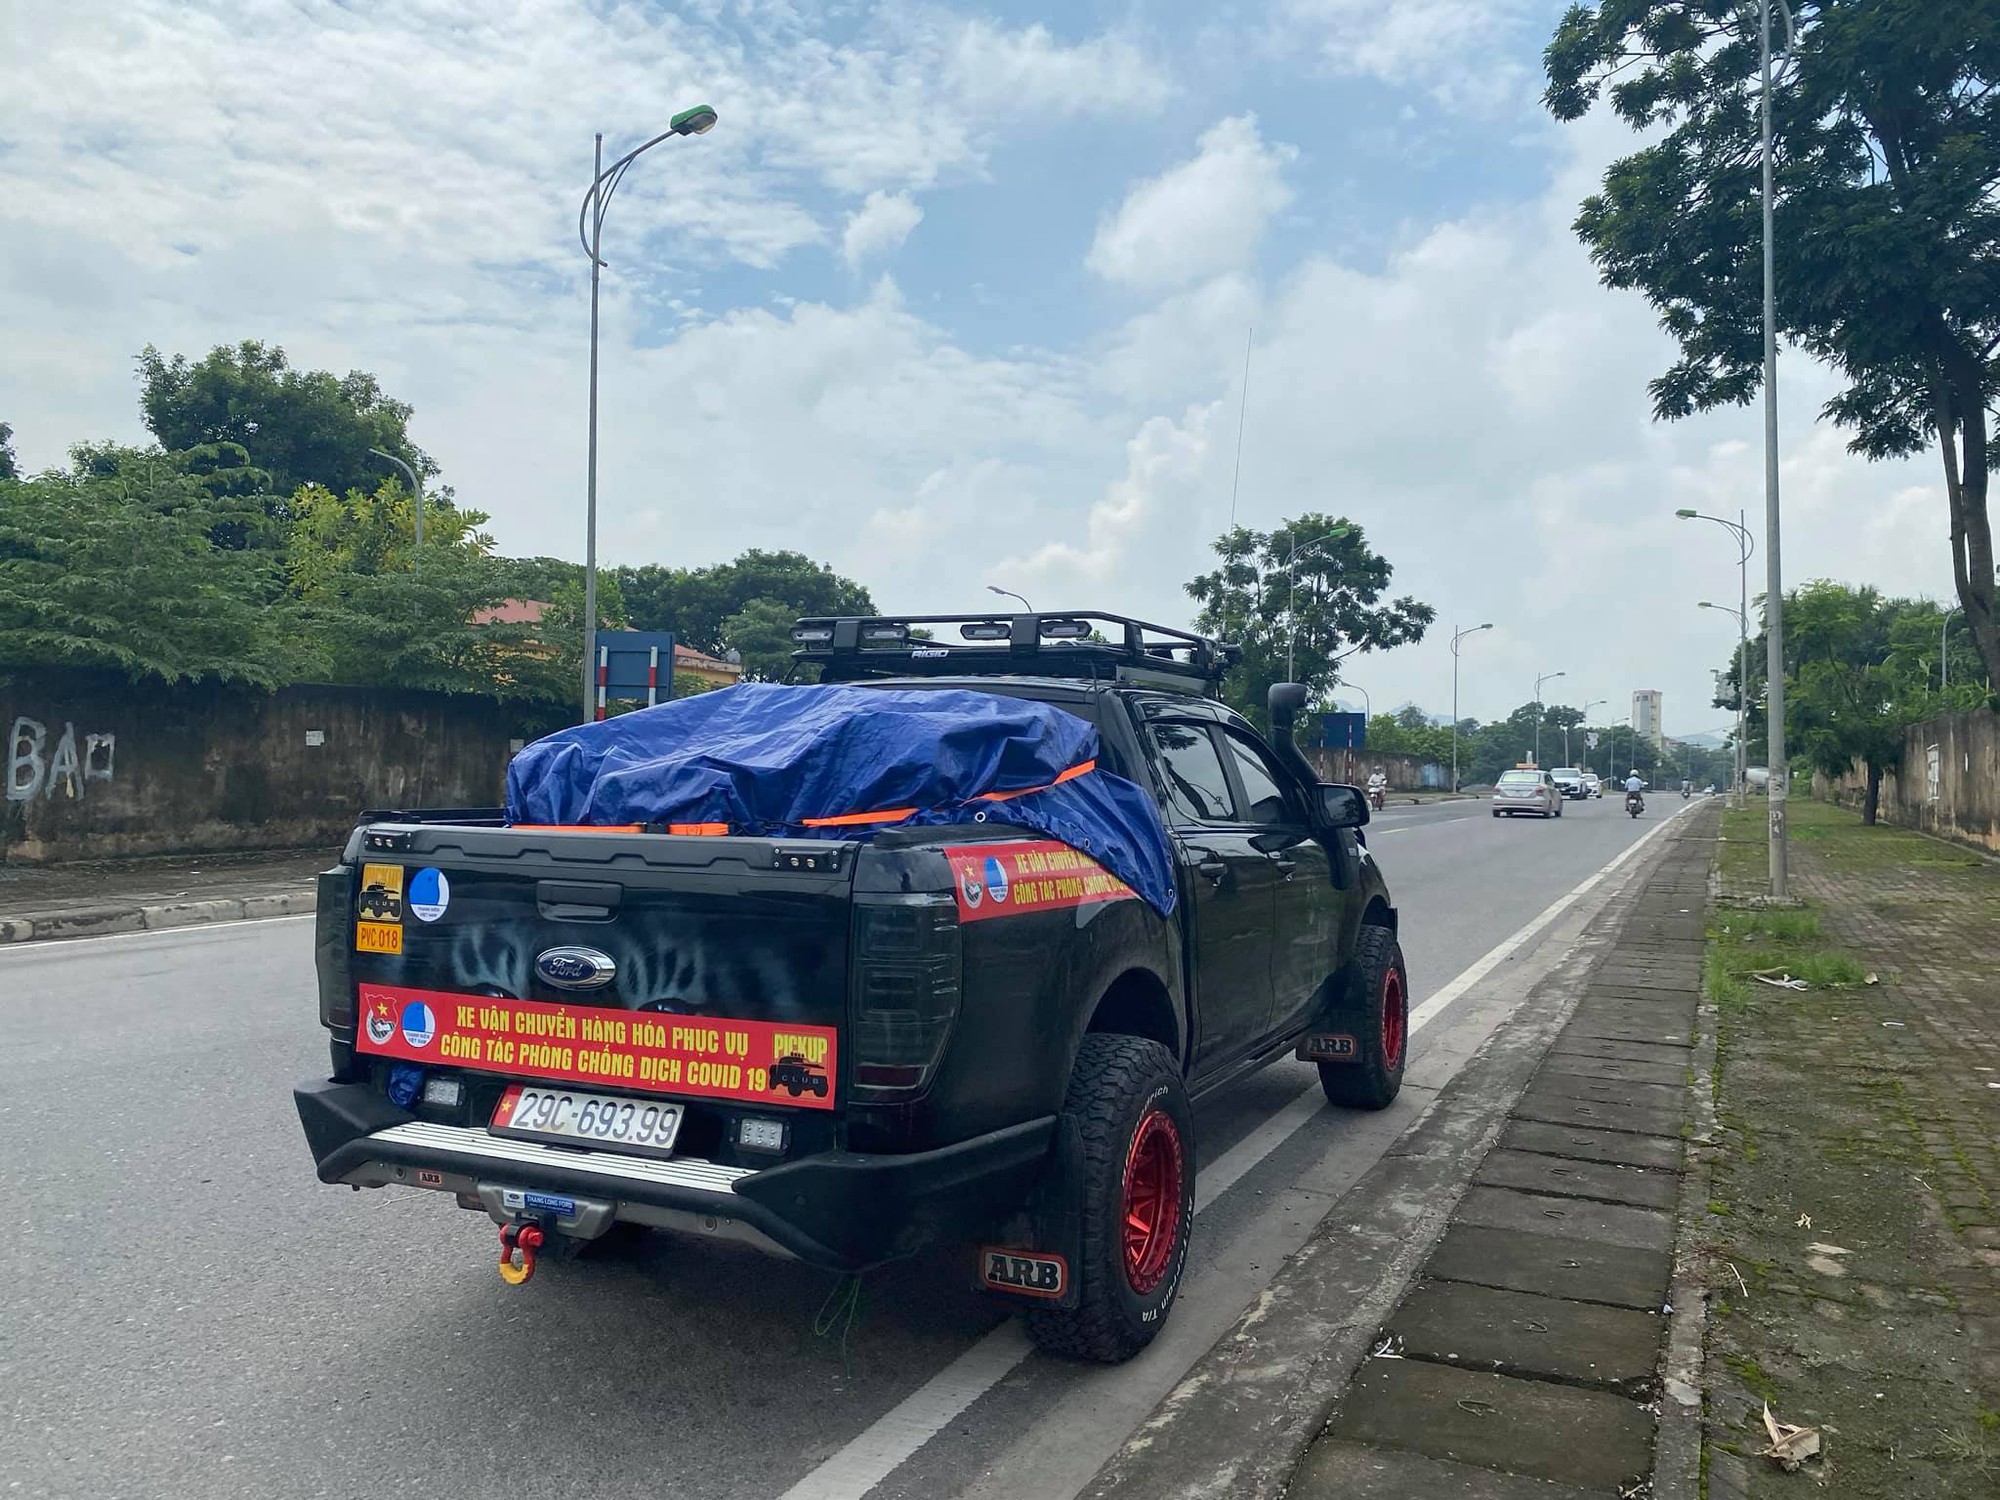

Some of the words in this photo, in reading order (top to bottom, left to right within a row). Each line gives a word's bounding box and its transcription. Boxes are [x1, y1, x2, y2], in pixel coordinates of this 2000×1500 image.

[361, 927, 376, 947] PVC
[378, 929, 398, 949] 018
[548, 956, 583, 979] Ford
[457, 1005, 475, 1028] XE
[480, 1004, 510, 1036] VẬN
[515, 1007, 576, 1040] CHUYỂN
[582, 1015, 626, 1045] HÀNG
[632, 1019, 666, 1048] HÓA
[672, 1027, 719, 1057] PHỤC
[725, 1031, 749, 1061] VỤ
[774, 1033, 828, 1063] PICKUP
[1309, 1037, 1352, 1055] ARB
[441, 1032, 481, 1057] CÔNG
[486, 1037, 514, 1064] TÁC
[519, 1042, 572, 1071] PHÒNG
[577, 1045, 634, 1078] CHỐNG
[640, 1057, 681, 1085] DỊCH
[687, 1061, 741, 1090] COVID
[747, 1068, 767, 1092] 19
[781, 1074, 819, 1085] CLUB
[421, 1172, 440, 1184] ARB
[990, 1254, 1059, 1291] ARB
